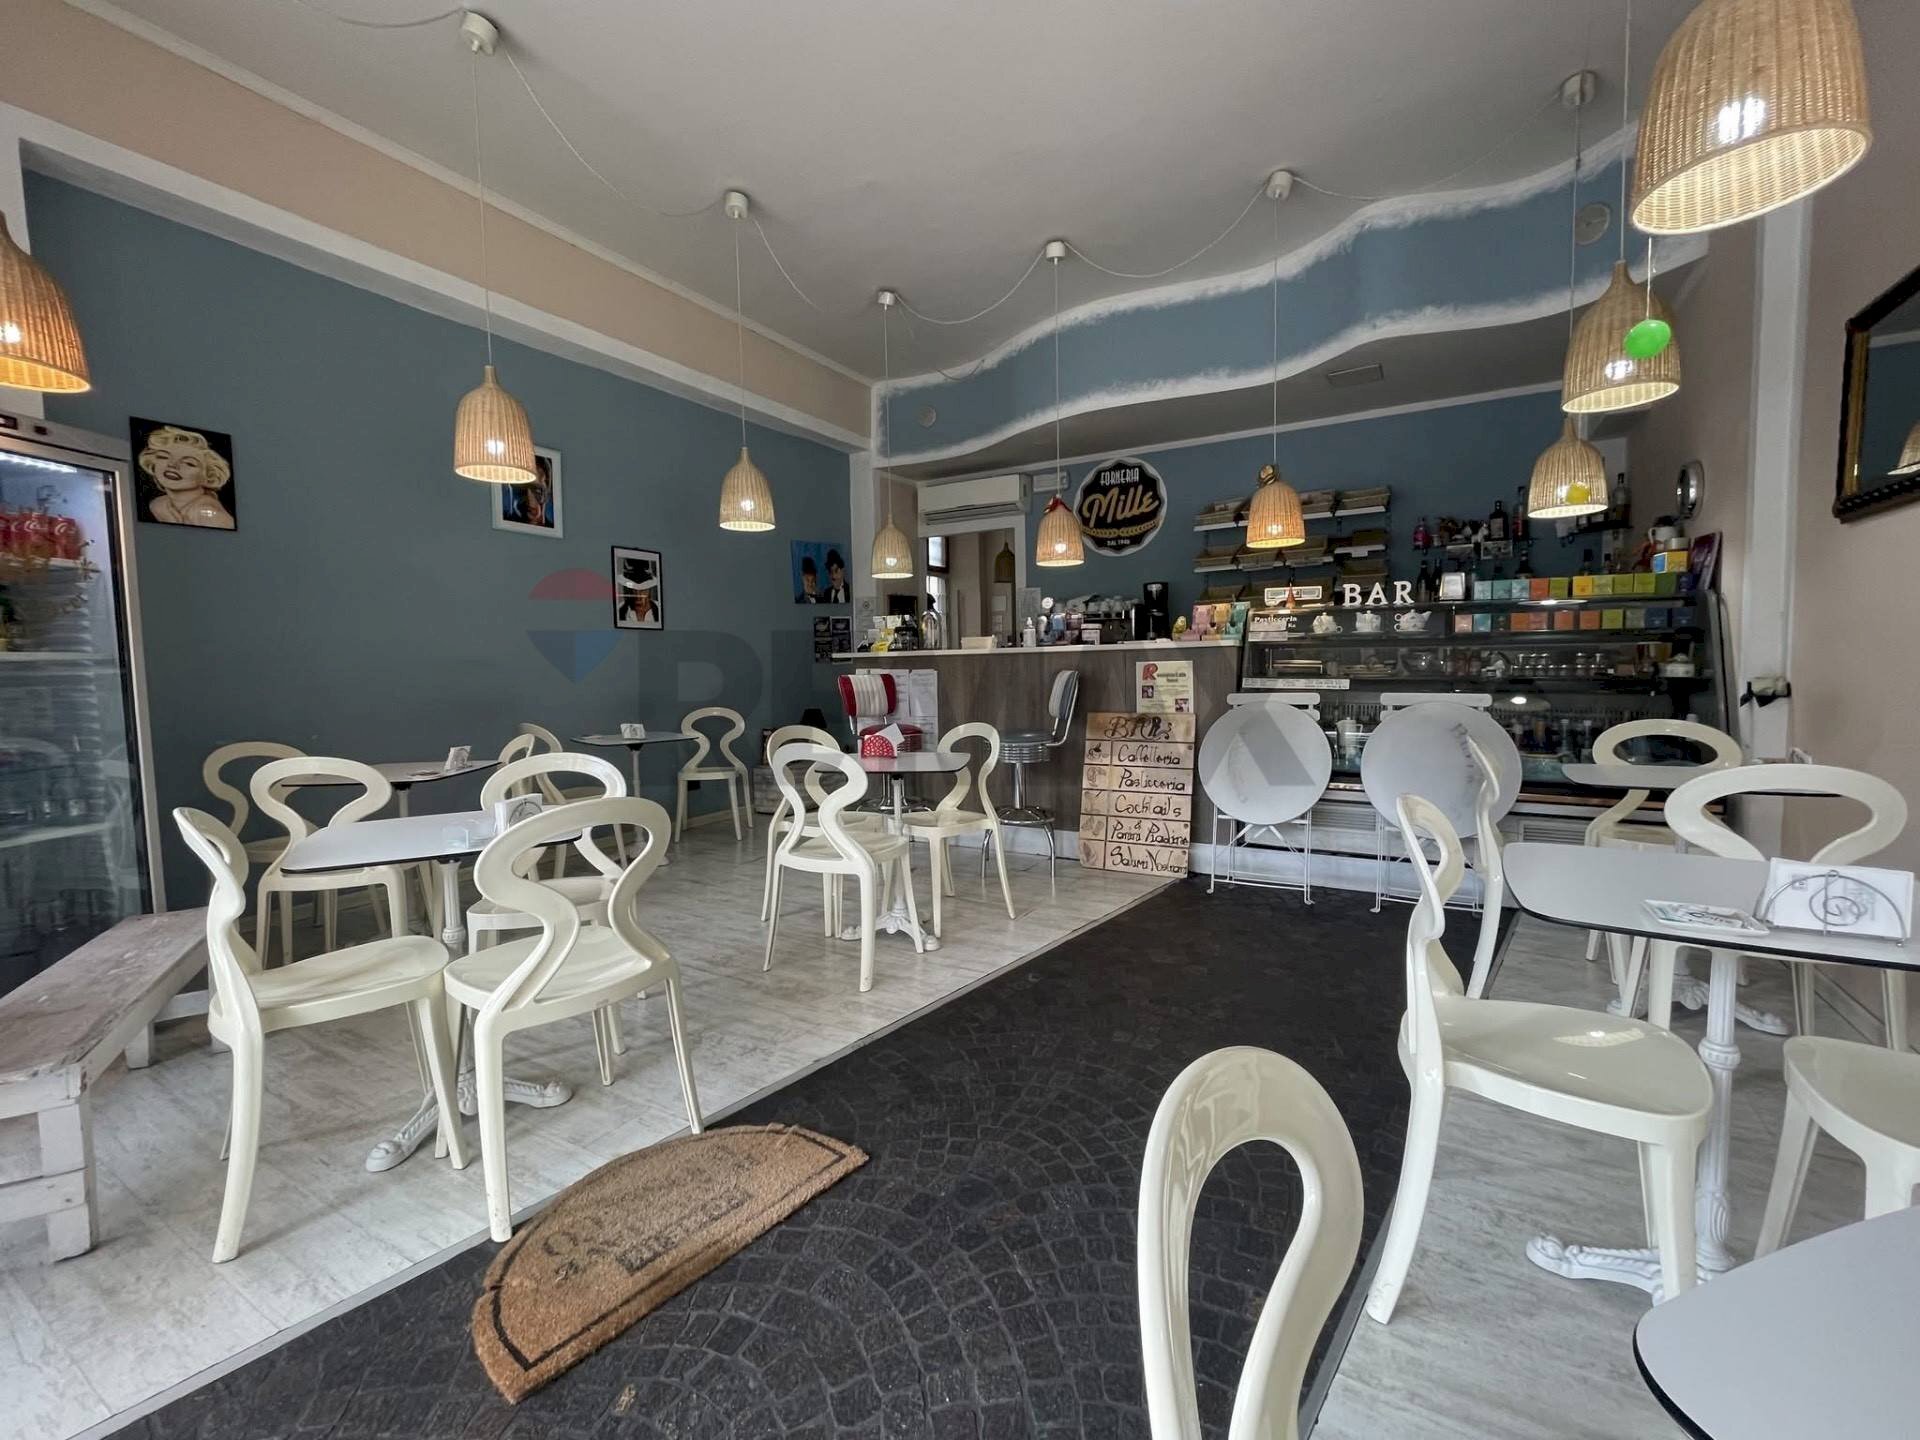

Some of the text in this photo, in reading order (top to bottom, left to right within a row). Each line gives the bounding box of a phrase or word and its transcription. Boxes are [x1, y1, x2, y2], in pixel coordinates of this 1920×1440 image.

[1100, 467, 1140, 486] FORNERIA
[1082, 484, 1159, 528] Mille
[1342, 580, 1414, 607] BAR
[1117, 743, 1181, 766] Caffetteria
[1118, 767, 1186, 792] Pasticceria
[1114, 794, 1182, 818] Cocktails
[1110, 819, 1141, 841] Panini
[1144, 821, 1189, 846] Piadine
[1110, 845, 1149, 870] Salumi
